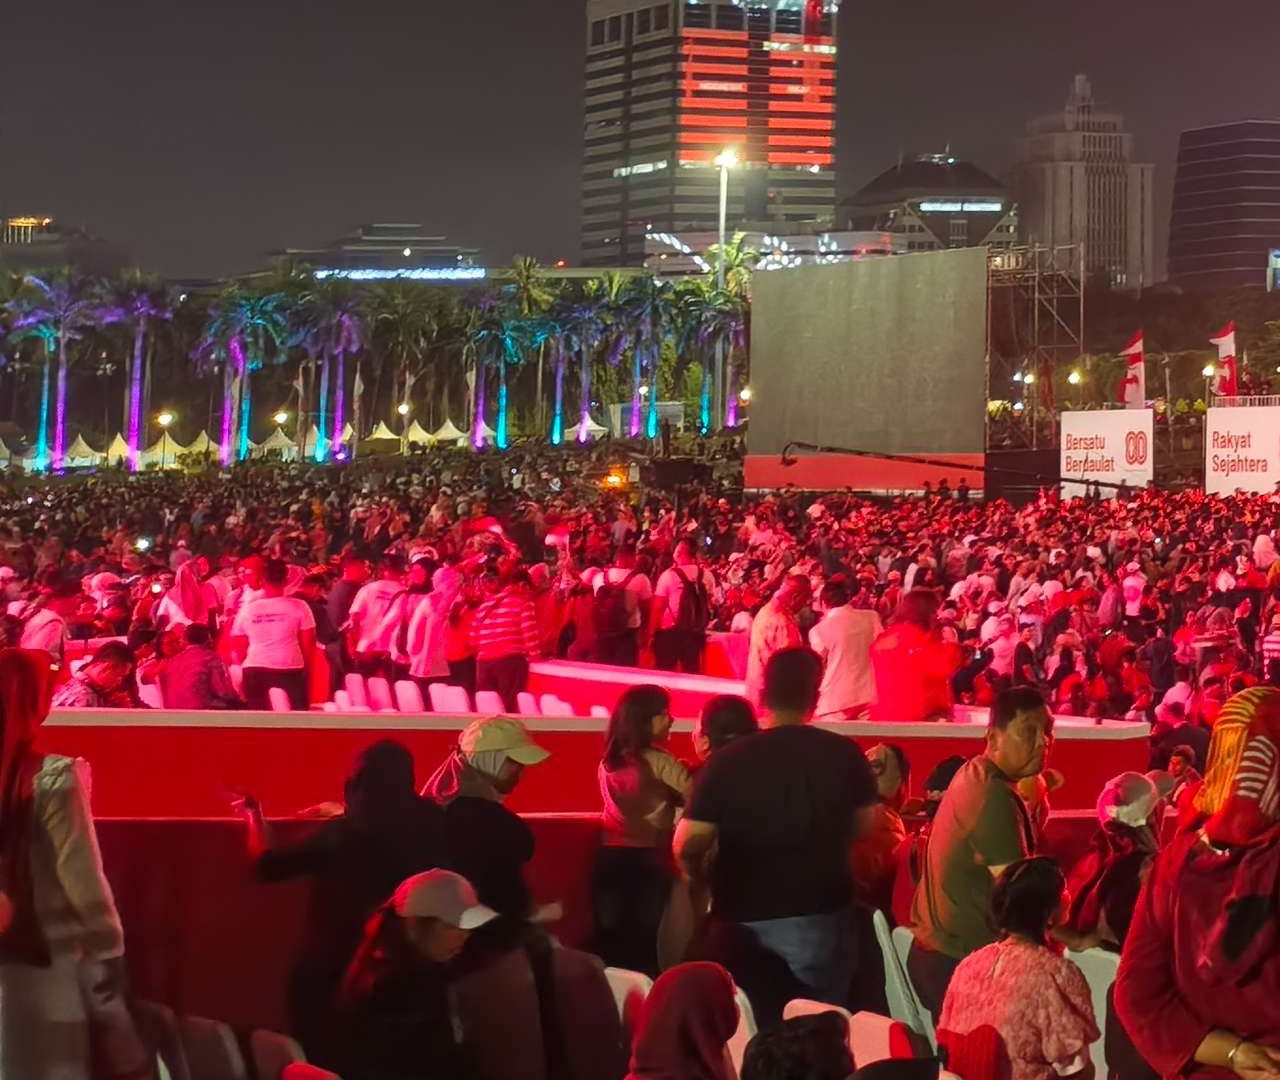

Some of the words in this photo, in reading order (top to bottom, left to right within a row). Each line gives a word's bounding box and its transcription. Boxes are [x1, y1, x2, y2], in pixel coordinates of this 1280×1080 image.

[1066, 433, 1105, 451] Bersatu
[1212, 430, 1251, 453] Rakyat
[1212, 454, 1268, 477] Sejahtera
